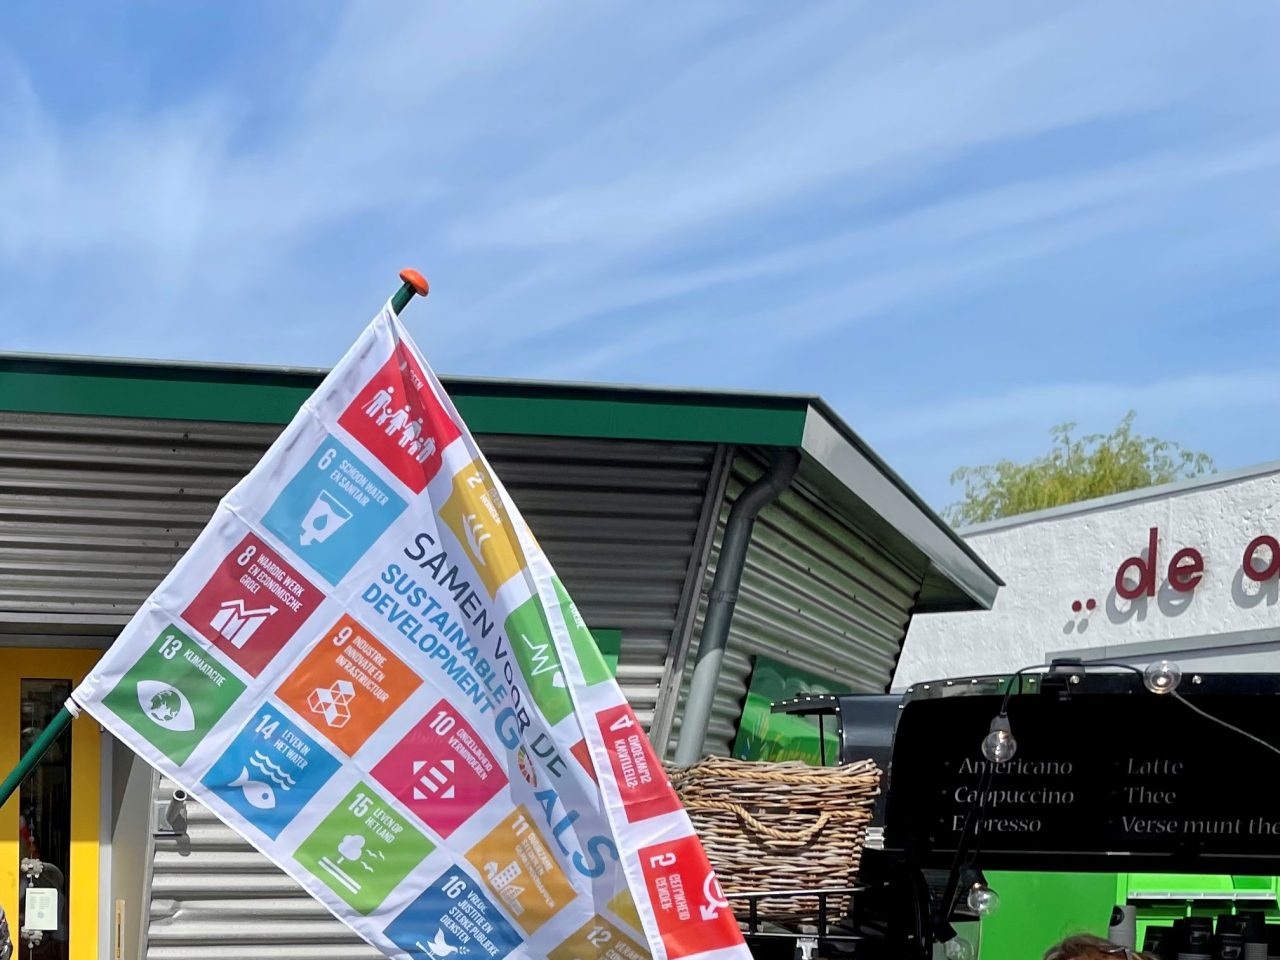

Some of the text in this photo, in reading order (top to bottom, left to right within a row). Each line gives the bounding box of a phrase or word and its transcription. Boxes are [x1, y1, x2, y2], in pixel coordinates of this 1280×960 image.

[318, 448, 389, 507] 6 SCHOON WATER
[330, 470, 371, 507] EN SANITAIR
[466, 471, 485, 488] 2
[237, 545, 305, 597] 8 WAARDIG WERK
[240, 574, 261, 594] GROEI
[248, 563, 303, 613] EN ECONOMISCHE
[333, 626, 353, 646] 9
[362, 583, 496, 714] DEVELOPMENT
[381, 563, 507, 702] SUSTAINABLE
[403, 533, 495, 638] SAMEN
[494, 636, 531, 735] VOOR
[159, 634, 227, 687] 13 KLIMAATACTIE
[344, 645, 386, 683] INNOVATIE EN
[335, 654, 390, 703] INFRASTRUCTUUR
[255, 714, 311, 756] 14 LEVEN IN
[428, 710, 456, 736] 10
[273, 738, 309, 770] HET WATER
[448, 735, 488, 780] VERMINDEREN
[958, 757, 1073, 775] Americano
[1128, 758, 1184, 775] Latte
[954, 786, 1075, 807] Cappuccino
[1124, 786, 1177, 804] Thee
[347, 793, 404, 834] 15 LEVEN OP
[511, 815, 530, 837] 11
[952, 815, 1042, 835] Epresso
[1122, 816, 1178, 833] Verse
[1183, 819, 1241, 834] munt
[365, 816, 396, 844] HET LAND
[441, 875, 467, 899] 16
[440, 914, 471, 944] DIENSTEN
[448, 906, 500, 957] STERKE PUBLIEKE
[457, 900, 494, 934] JUSTITIE EN
[587, 926, 612, 948] 12
